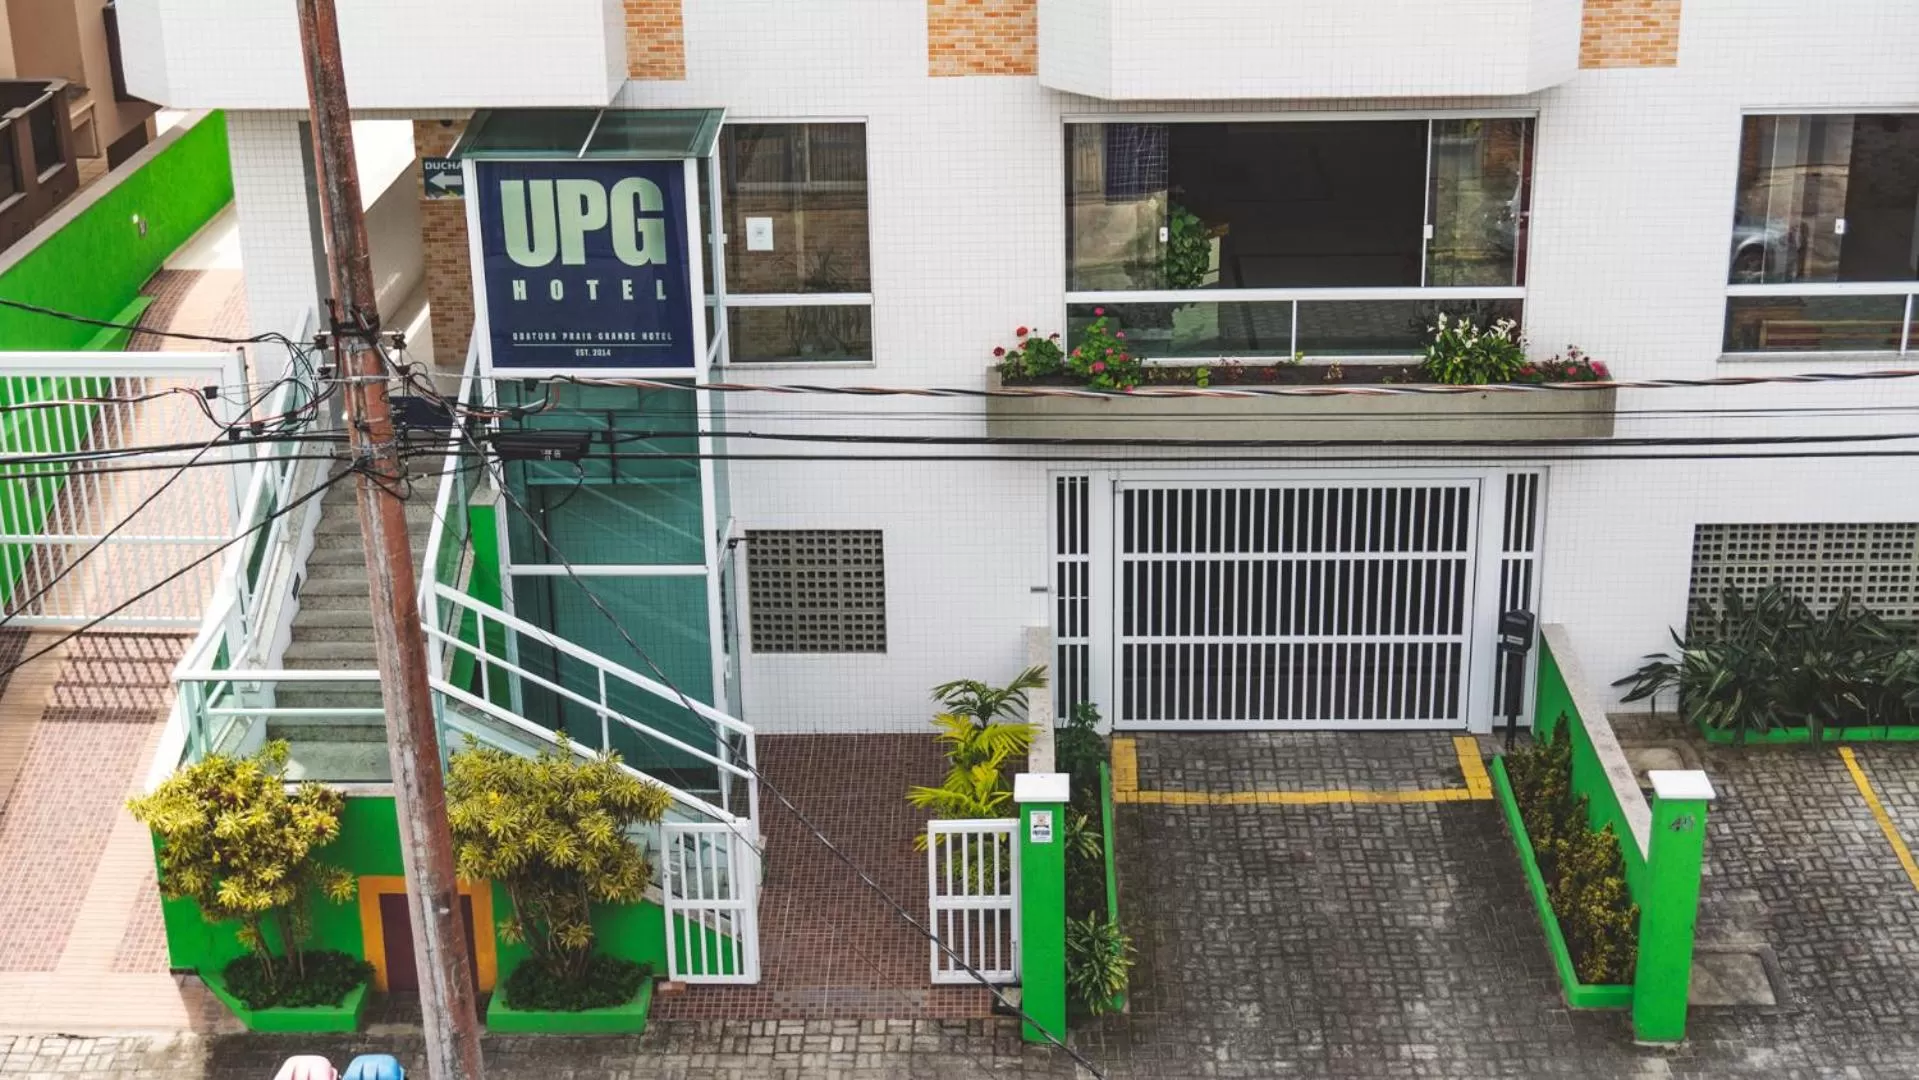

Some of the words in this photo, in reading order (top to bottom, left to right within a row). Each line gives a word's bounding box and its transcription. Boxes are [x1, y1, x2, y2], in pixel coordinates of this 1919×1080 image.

[500, 176, 667, 267] UPG
[512, 279, 667, 301] HOTEL
[562, 332, 592, 341] PRAIA
[598, 332, 635, 341] GRANDE
[641, 332, 672, 341] HOTEL
